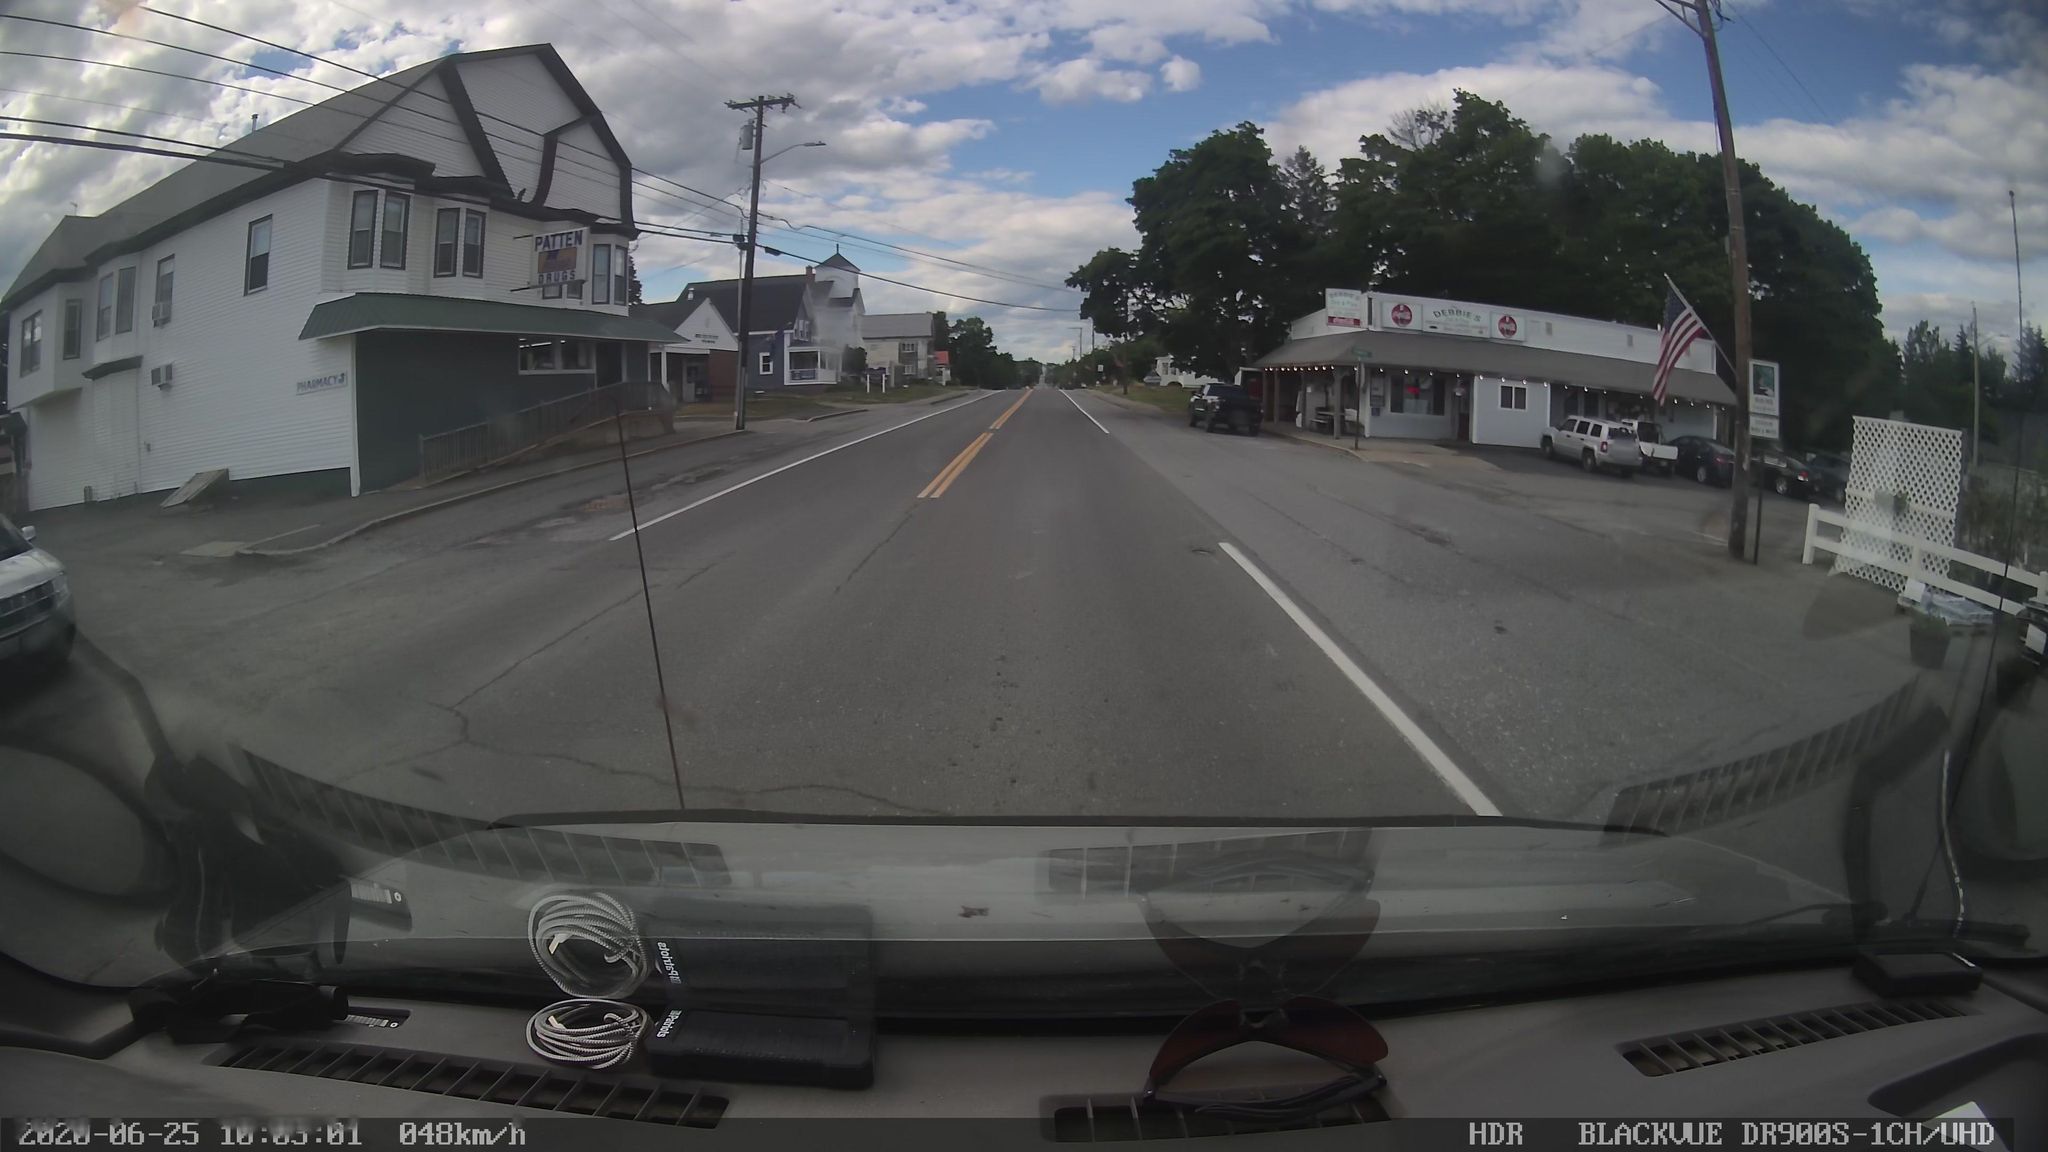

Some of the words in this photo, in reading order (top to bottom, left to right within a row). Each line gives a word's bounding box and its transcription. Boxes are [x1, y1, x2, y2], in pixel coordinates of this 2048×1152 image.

[534, 230, 584, 252] PATTEN
[538, 270, 577, 285] DRUGS
[1432, 308, 1482, 322] DEBBIE'S
[296, 374, 337, 393] PHARMACY
